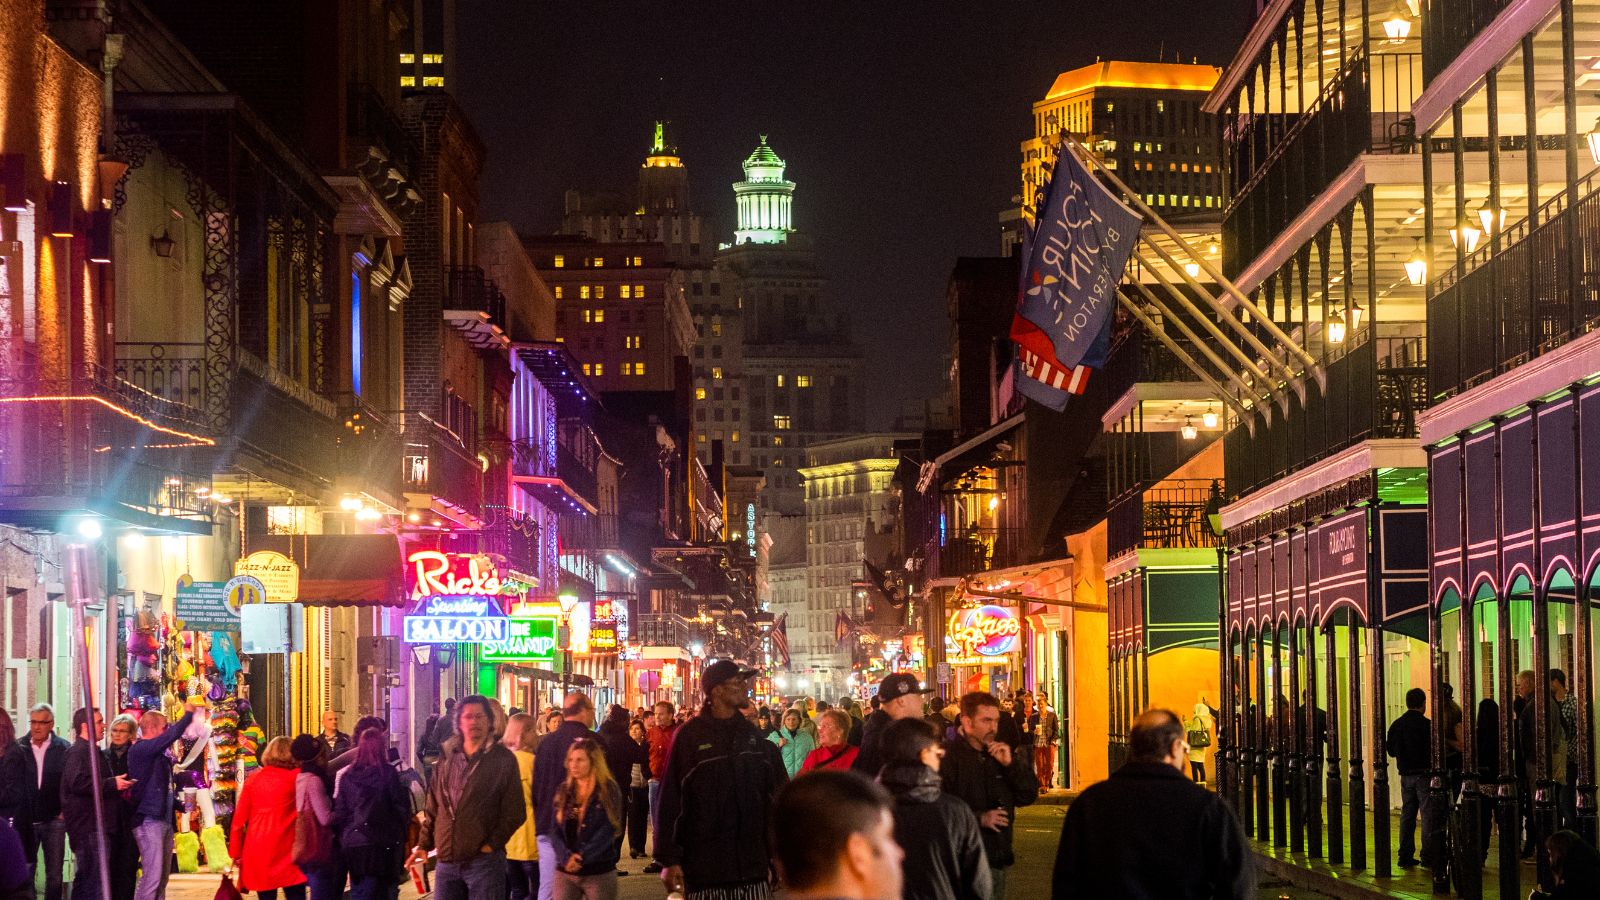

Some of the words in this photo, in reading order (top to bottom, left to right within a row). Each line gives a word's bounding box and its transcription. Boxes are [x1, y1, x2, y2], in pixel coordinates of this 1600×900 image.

[408, 551, 501, 596] Rick's
[427, 597, 487, 616] Sporting
[411, 620, 502, 640] SALOON
[511, 622, 530, 637] HE
[590, 629, 614, 638] HRIS
[483, 637, 554, 655] SWAMP
[589, 638, 616, 648] WENS
